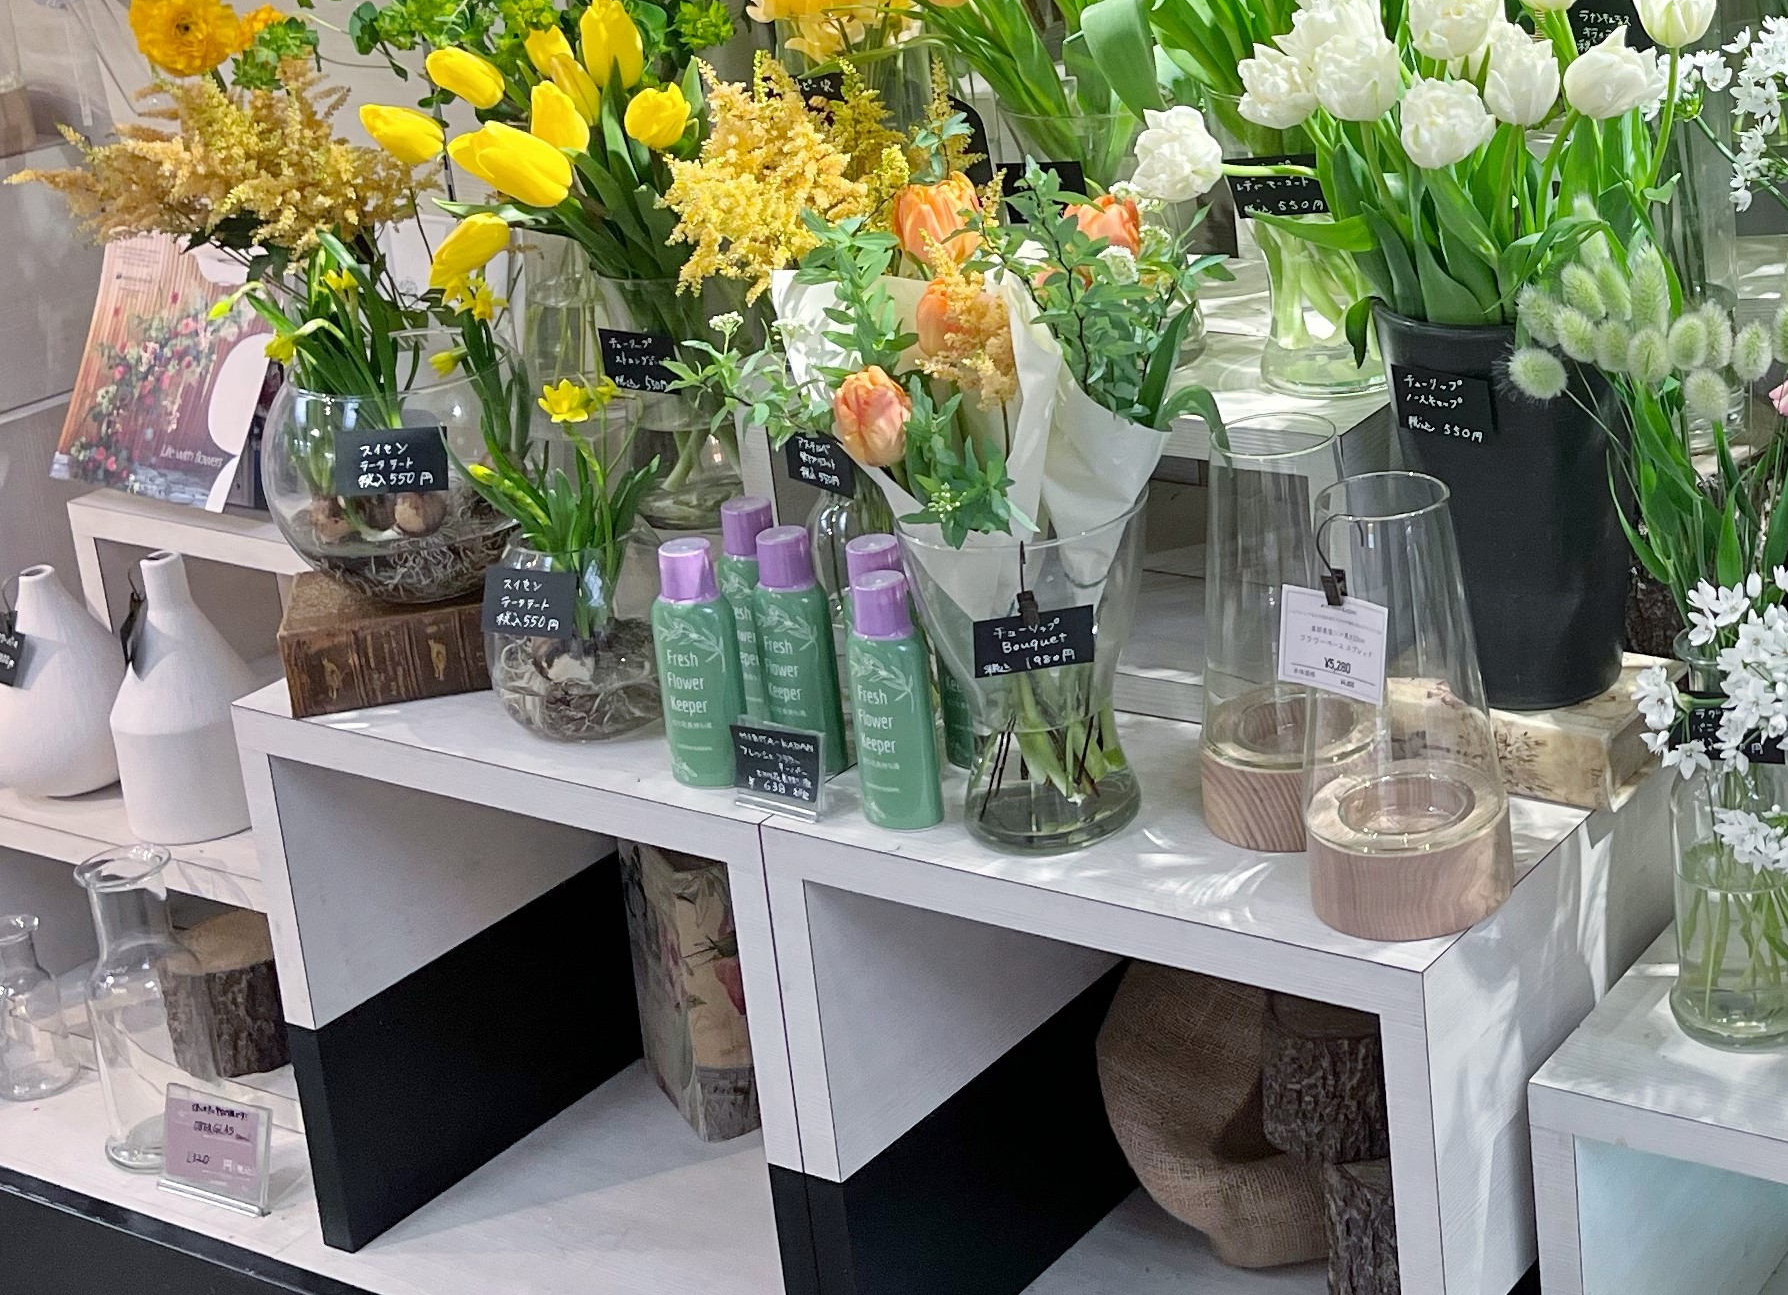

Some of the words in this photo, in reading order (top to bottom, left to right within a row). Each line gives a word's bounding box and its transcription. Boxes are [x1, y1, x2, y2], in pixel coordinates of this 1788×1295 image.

[1277, 199, 1324, 212] 550円
[1403, 374, 1463, 392] チューリップ
[1406, 393, 1463, 409] ノースキャップ
[1443, 423, 1483, 443] 550円
[359, 442, 409, 458] スイセン
[503, 577, 543, 592] スイセン
[993, 617, 1061, 640] チューリップ
[763, 635, 794, 655] Fresh
[1001, 633, 1068, 654] Bouquet
[666, 649, 699, 668] Fresh
[764, 658, 800, 678] Flower
[1025, 648, 1076, 670] 1980円
[666, 671, 705, 691] Flower
[767, 682, 802, 703] Keeper
[857, 684, 888, 706] Fresh
[670, 695, 708, 717] Keeper
[858, 708, 894, 730] Flower
[860, 732, 896, 755] Keeper
[763, 780, 786, 795] 638
